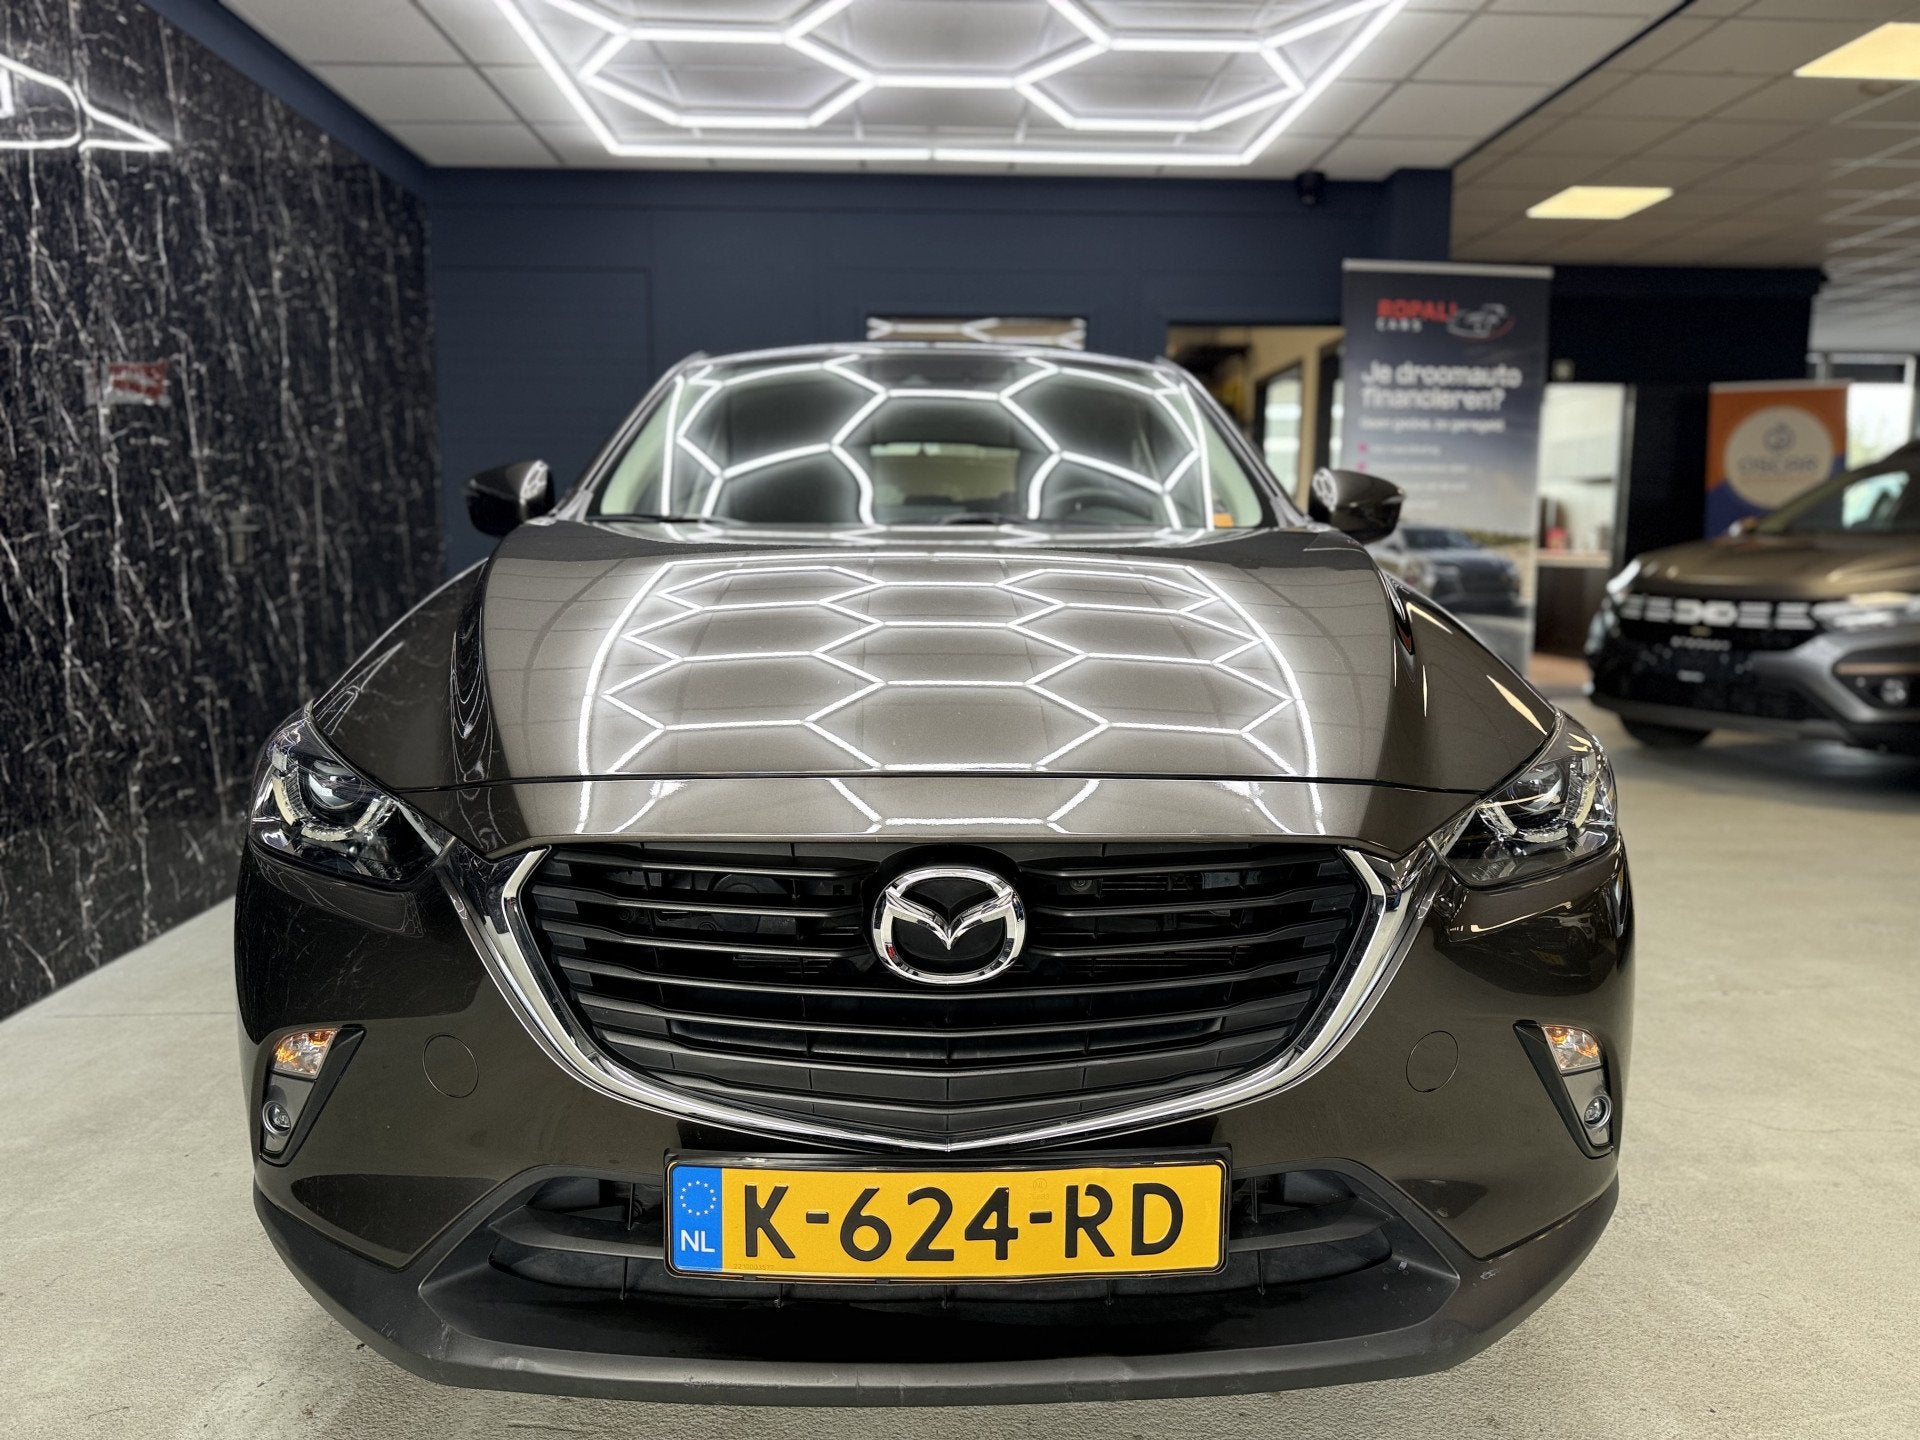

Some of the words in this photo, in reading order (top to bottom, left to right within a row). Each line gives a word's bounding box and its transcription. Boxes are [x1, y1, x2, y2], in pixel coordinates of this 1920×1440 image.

[1361, 360, 1393, 385] Je
[1395, 361, 1522, 388] droomauto
[1361, 386, 1506, 411] financieren?
[744, 1183, 1183, 1261] K-624-RD
[680, 1230, 715, 1252] NL
